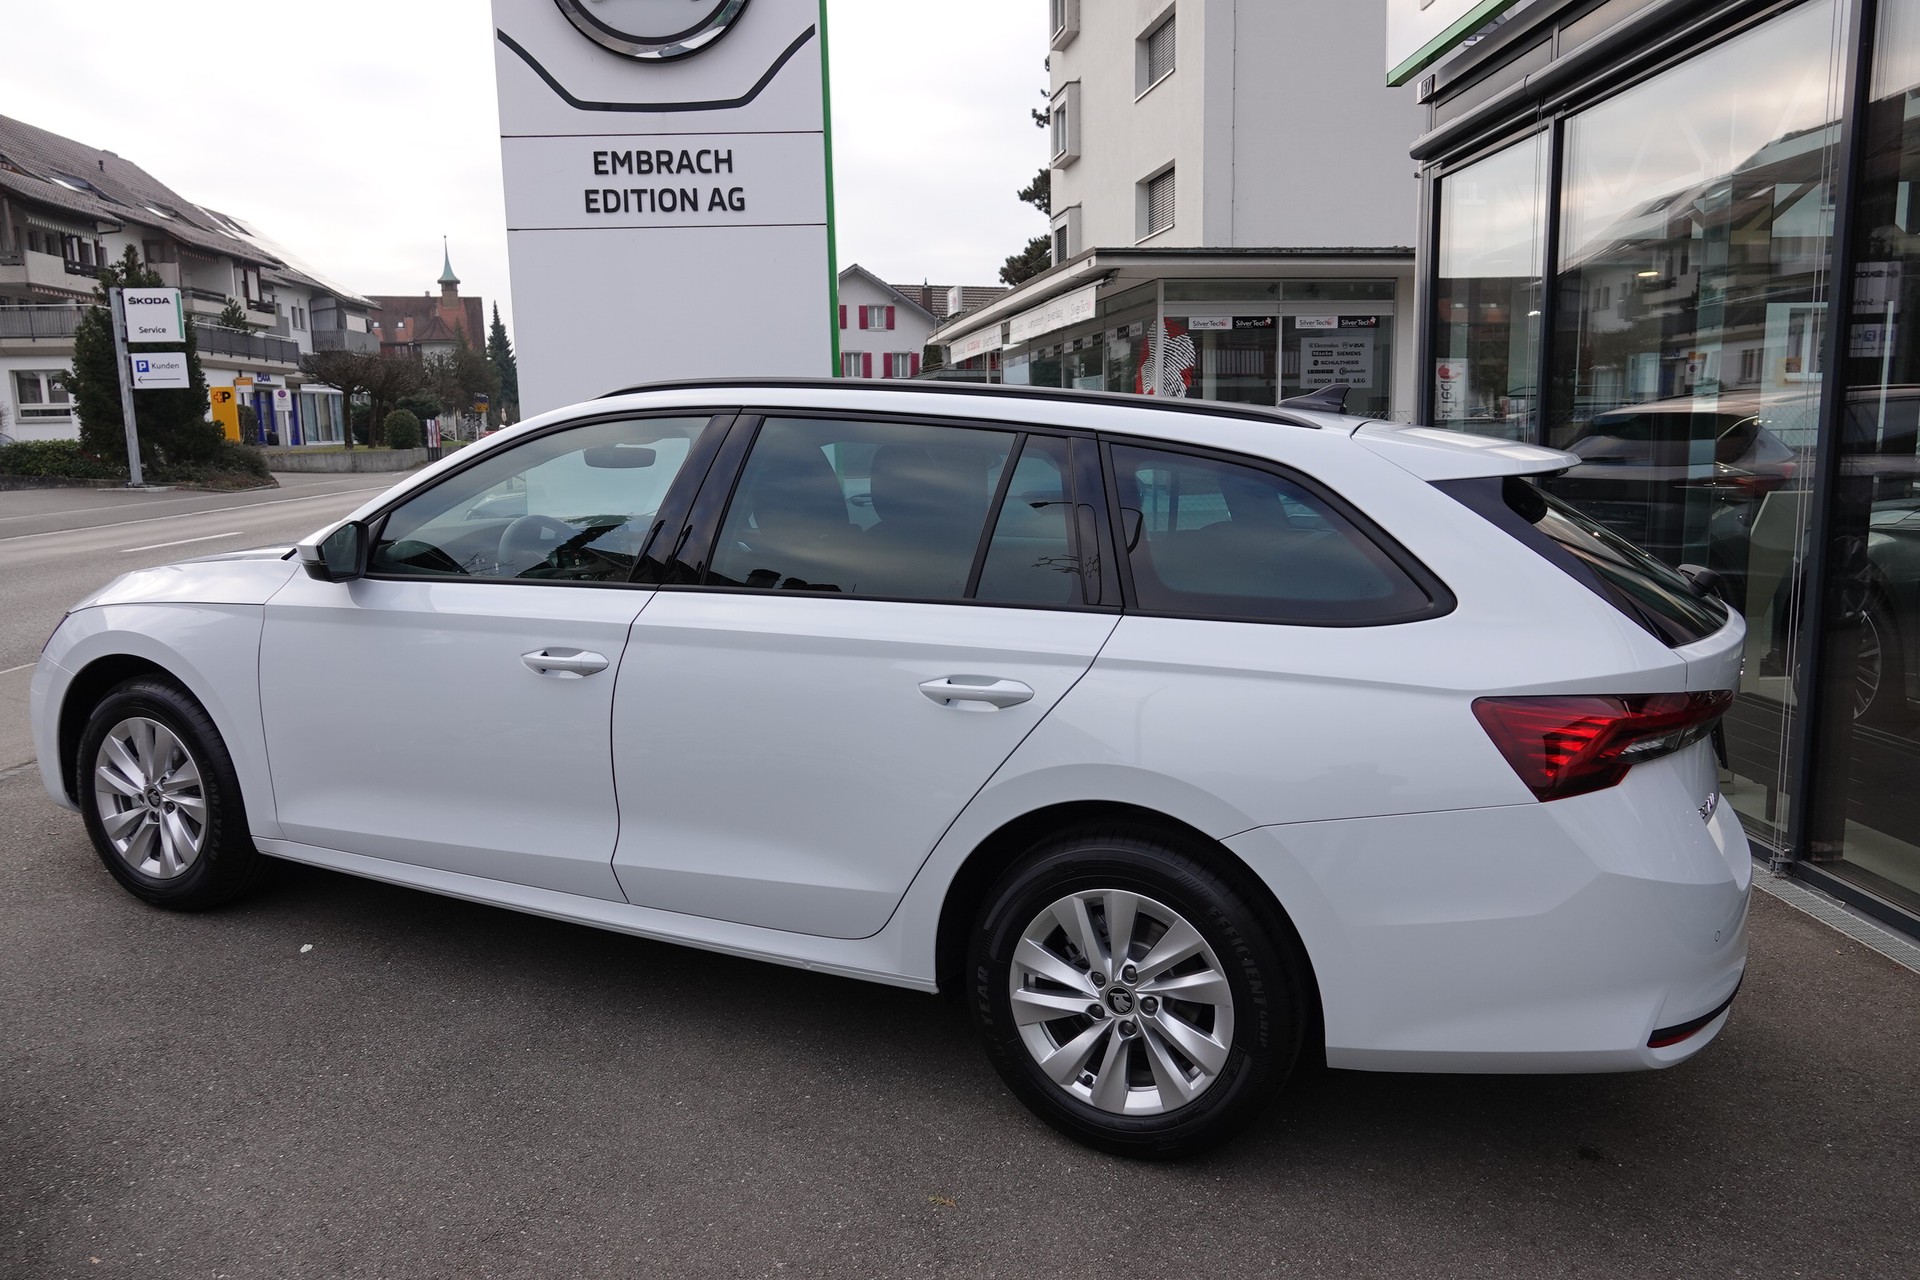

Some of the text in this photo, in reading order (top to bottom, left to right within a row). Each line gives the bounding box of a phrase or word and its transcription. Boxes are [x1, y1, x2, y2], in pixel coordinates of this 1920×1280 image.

[593, 149, 734, 175] EMBRACH
[584, 187, 745, 214] EDITION AG
[128, 296, 170, 305] ŠKODA
[139, 326, 167, 334] Service
